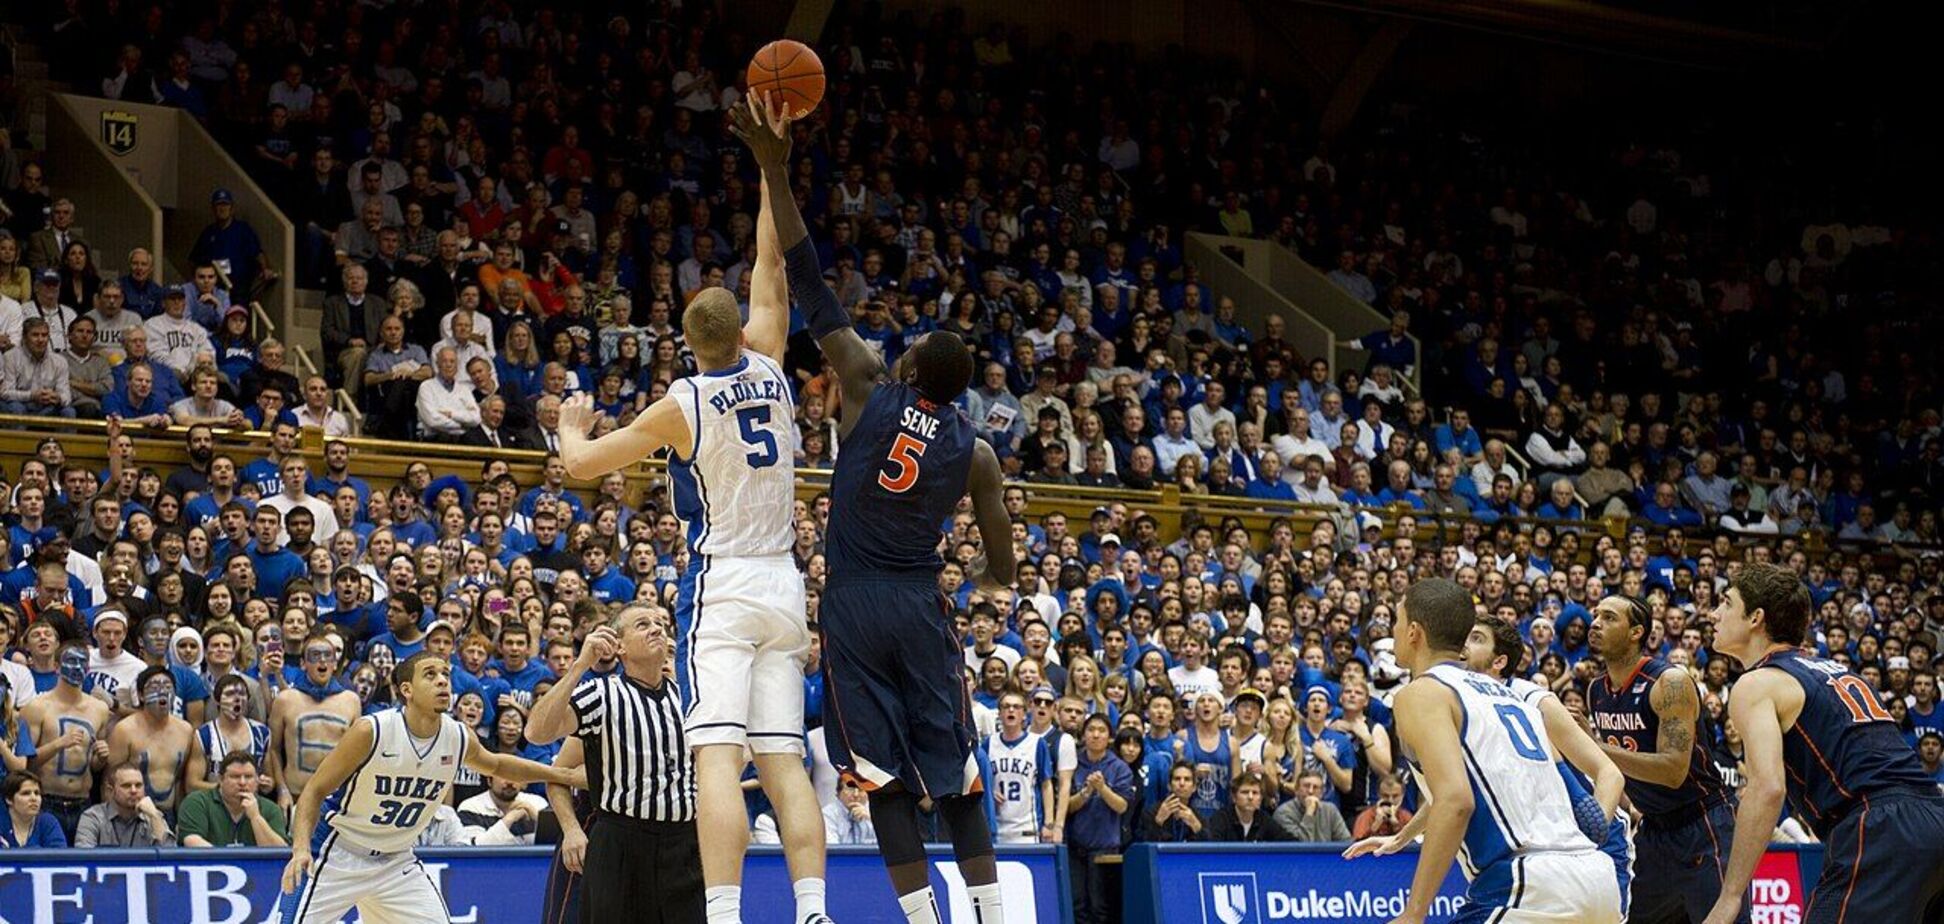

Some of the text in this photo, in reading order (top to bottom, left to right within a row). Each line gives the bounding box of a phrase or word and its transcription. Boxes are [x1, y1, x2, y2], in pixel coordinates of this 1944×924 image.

[109, 122, 132, 147] 14
[900, 406, 940, 439] SENE
[735, 404, 779, 470] 5
[878, 432, 928, 493] 5
[257, 479, 285, 496] DUK
[1493, 703, 1549, 762] 0
[1594, 711, 1647, 731] VIRGINIA
[991, 758, 1032, 777] DUKE
[374, 775, 446, 801] DUKE
[998, 781, 1021, 802] 12
[370, 800, 427, 828] 30
